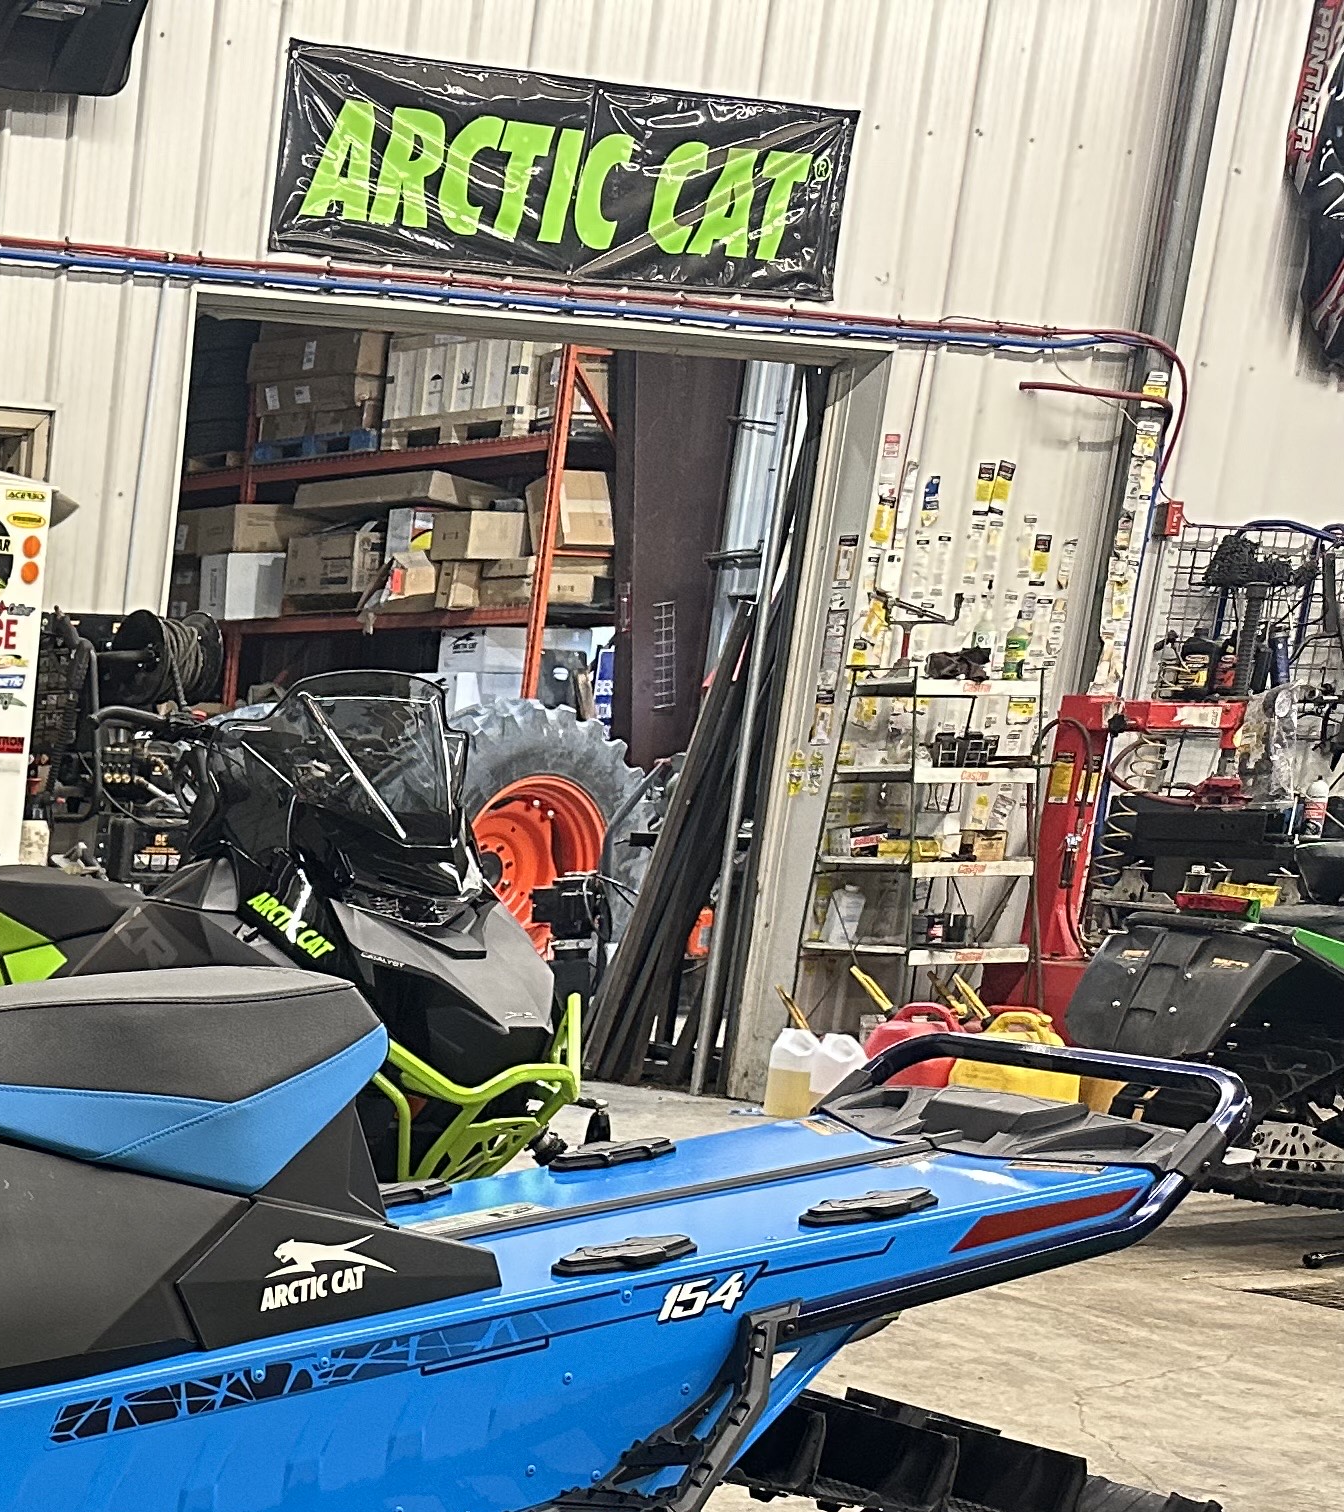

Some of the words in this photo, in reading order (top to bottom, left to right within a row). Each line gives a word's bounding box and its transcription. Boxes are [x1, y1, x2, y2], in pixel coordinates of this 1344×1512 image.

[1294, 7, 1333, 152] PANTHER
[299, 98, 634, 250] ARCTIC
[296, 929, 335, 959] CAT
[260, 1273, 329, 1312] ARCTIC
[330, 1264, 366, 1294] CAT
[657, 1271, 745, 1324] 154
